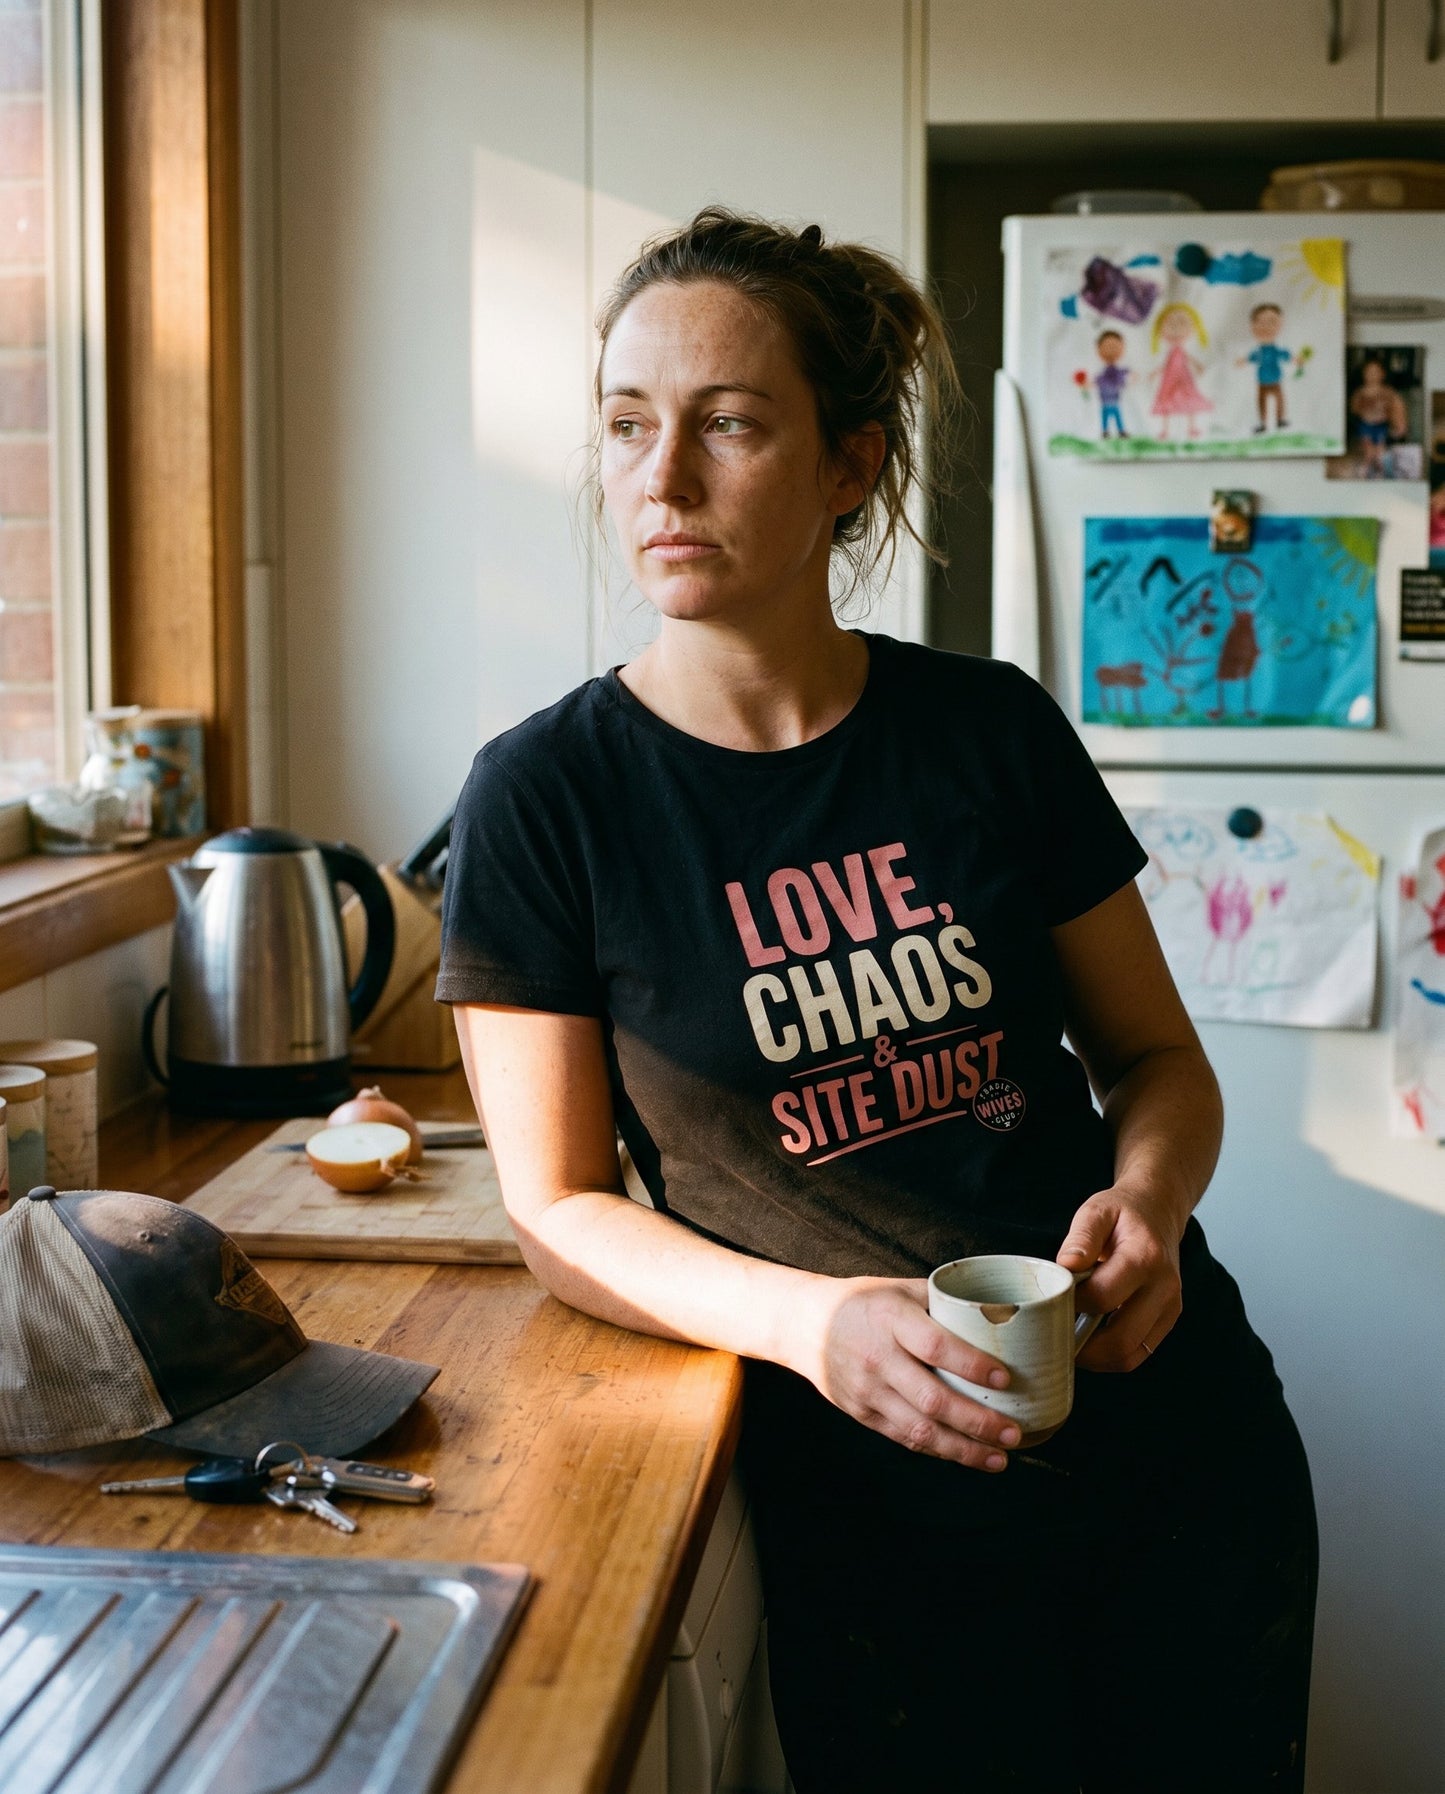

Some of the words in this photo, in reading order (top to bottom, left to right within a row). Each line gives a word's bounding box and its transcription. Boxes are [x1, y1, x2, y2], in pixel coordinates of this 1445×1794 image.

[725, 842, 954, 968] LOVE,
[743, 925, 992, 1062] CHAOS
[873, 1035, 897, 1067] &
[771, 1071, 884, 1154] SITE
[891, 1030, 1004, 1121] DUST
[977, 1092, 1022, 1118] WIVES
